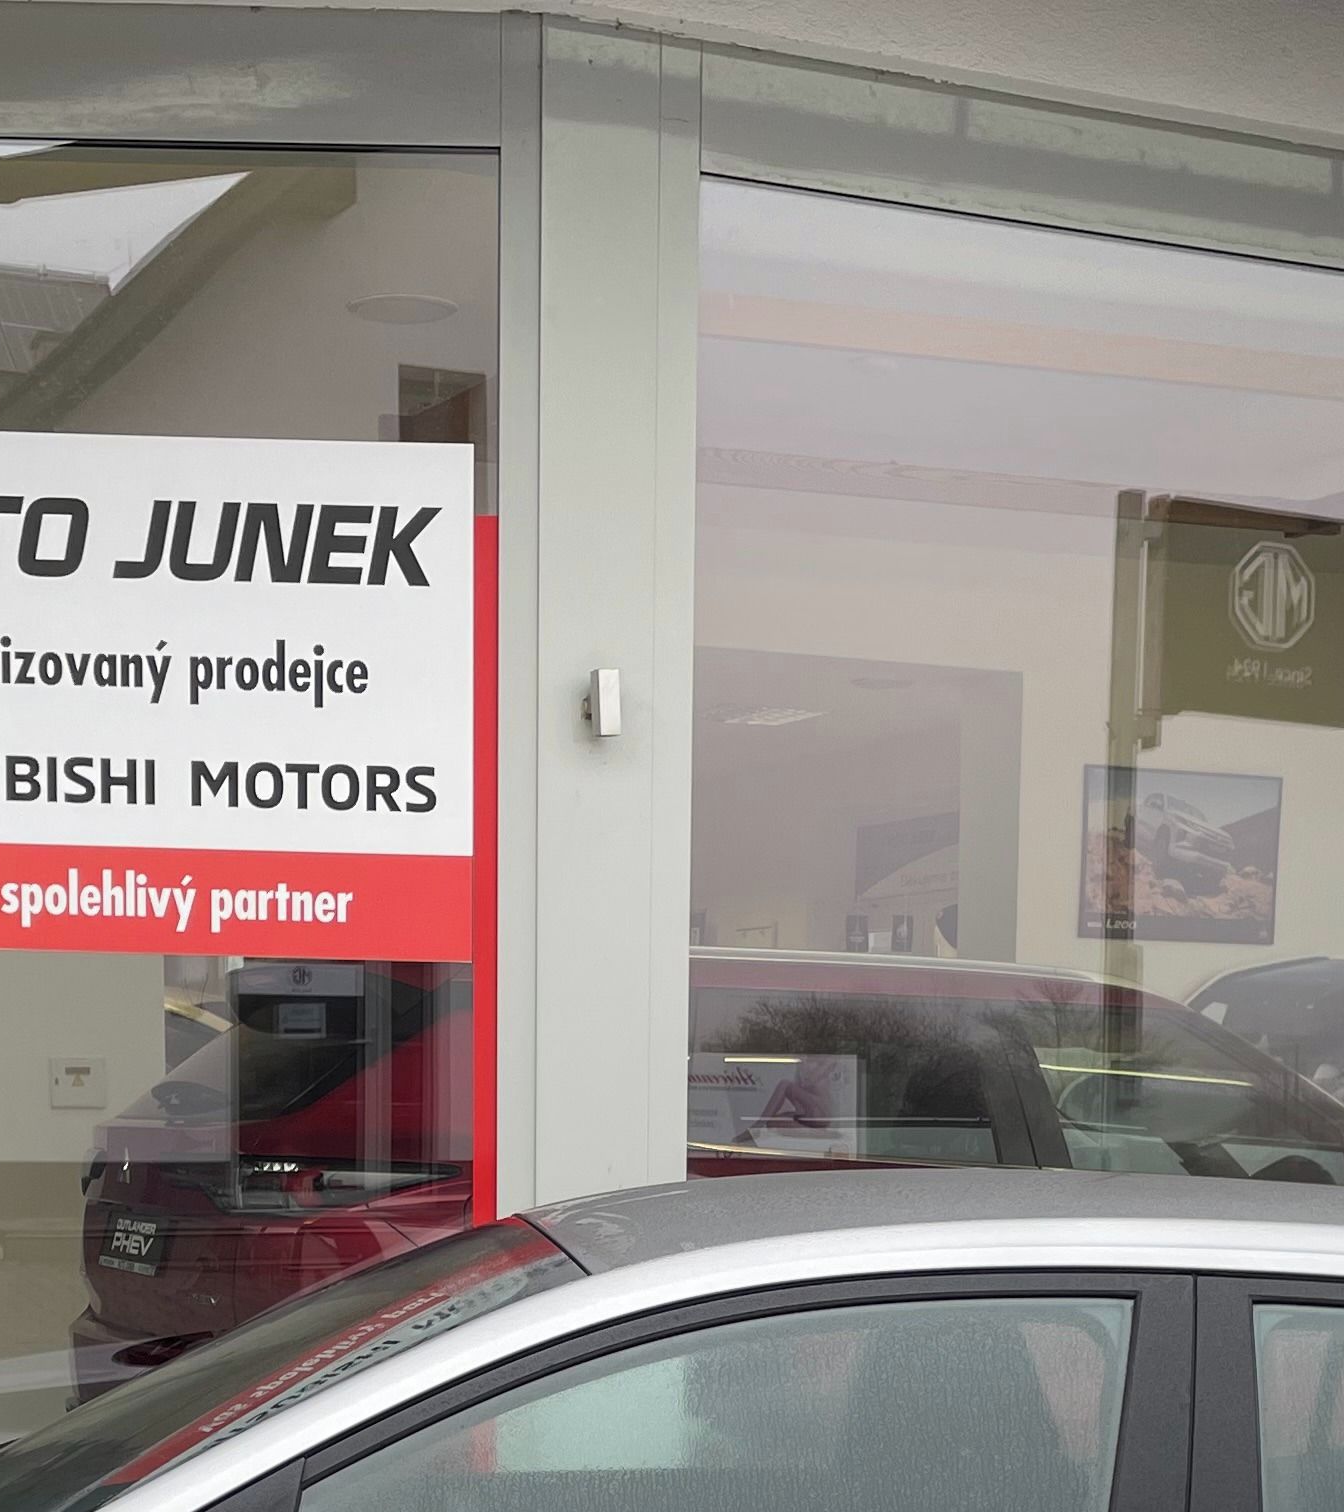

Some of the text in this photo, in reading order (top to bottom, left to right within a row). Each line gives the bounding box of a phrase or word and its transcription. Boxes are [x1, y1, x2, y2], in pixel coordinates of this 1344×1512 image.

[112, 499, 443, 587] JUNEK
[189, 640, 369, 709] prodejce
[190, 760, 437, 813] MOTORS
[0, 868, 197, 933] spolehlivý
[209, 880, 354, 933] partner
[111, 1231, 154, 1257] PHEV
[116, 1218, 157, 1236] OUTLANDER
